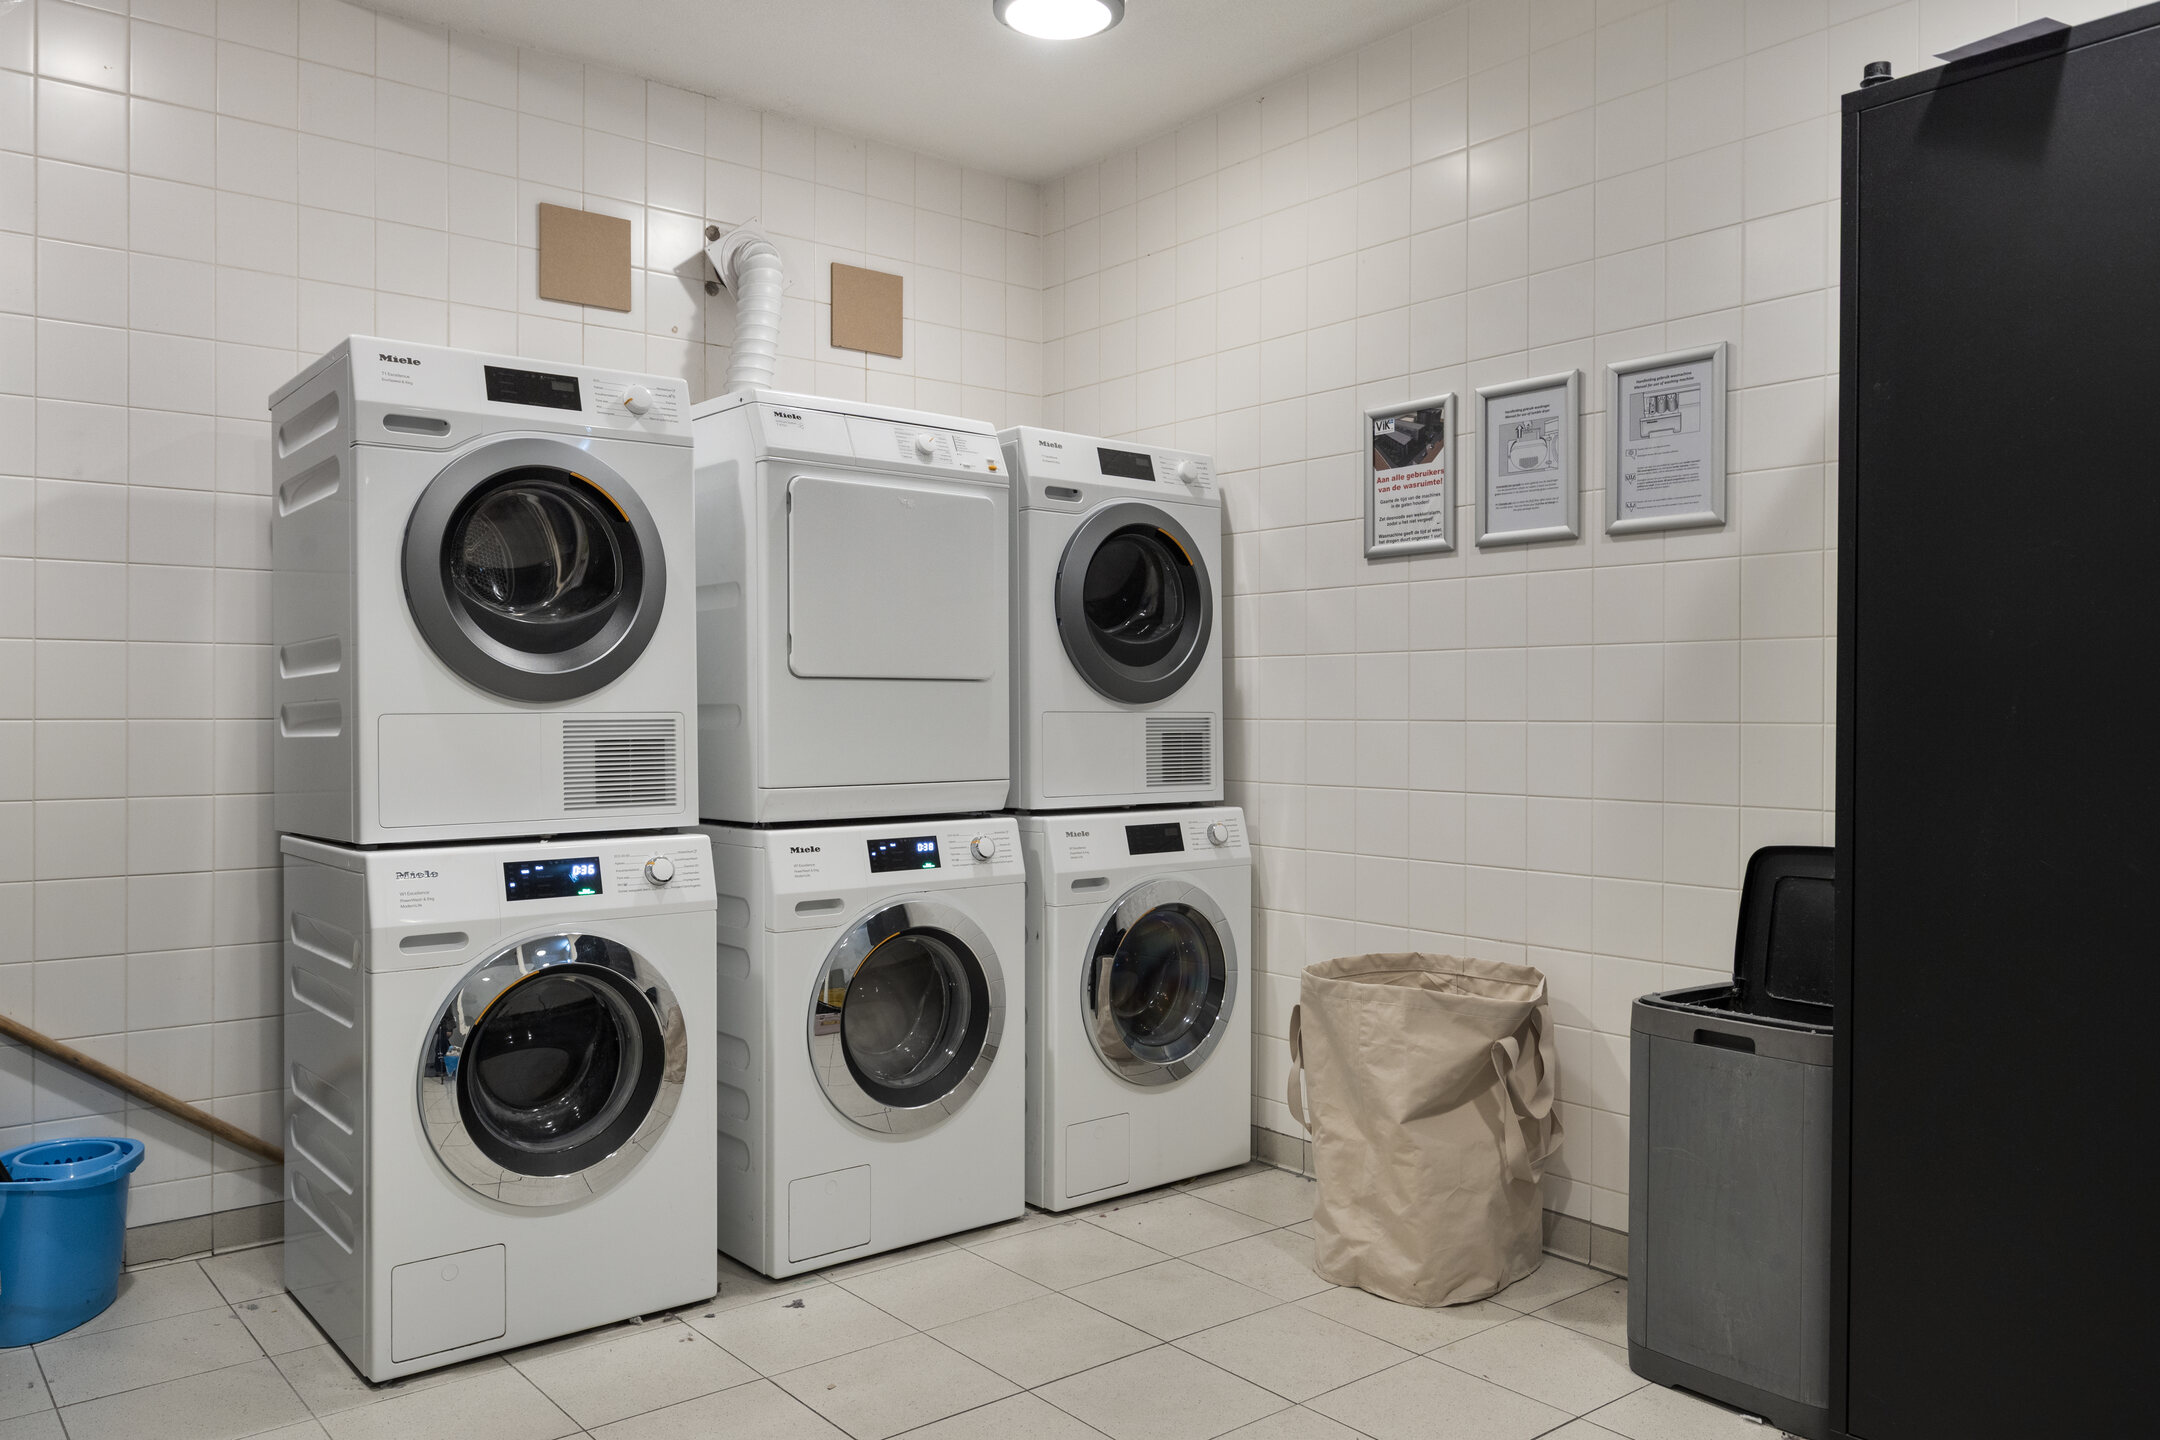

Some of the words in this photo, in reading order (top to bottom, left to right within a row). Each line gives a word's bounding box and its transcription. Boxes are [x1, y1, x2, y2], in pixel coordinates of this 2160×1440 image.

[379, 354, 421, 366] Miele
[774, 411, 802, 420] Miele
[1039, 440, 1063, 449] Miele
[1406, 469, 1444, 480] gebruikers
[1403, 478, 1443, 489] wasruimte!
[790, 846, 821, 854] Miele
[395, 870, 438, 879] Miele
[572, 864, 595, 875] 0:36
